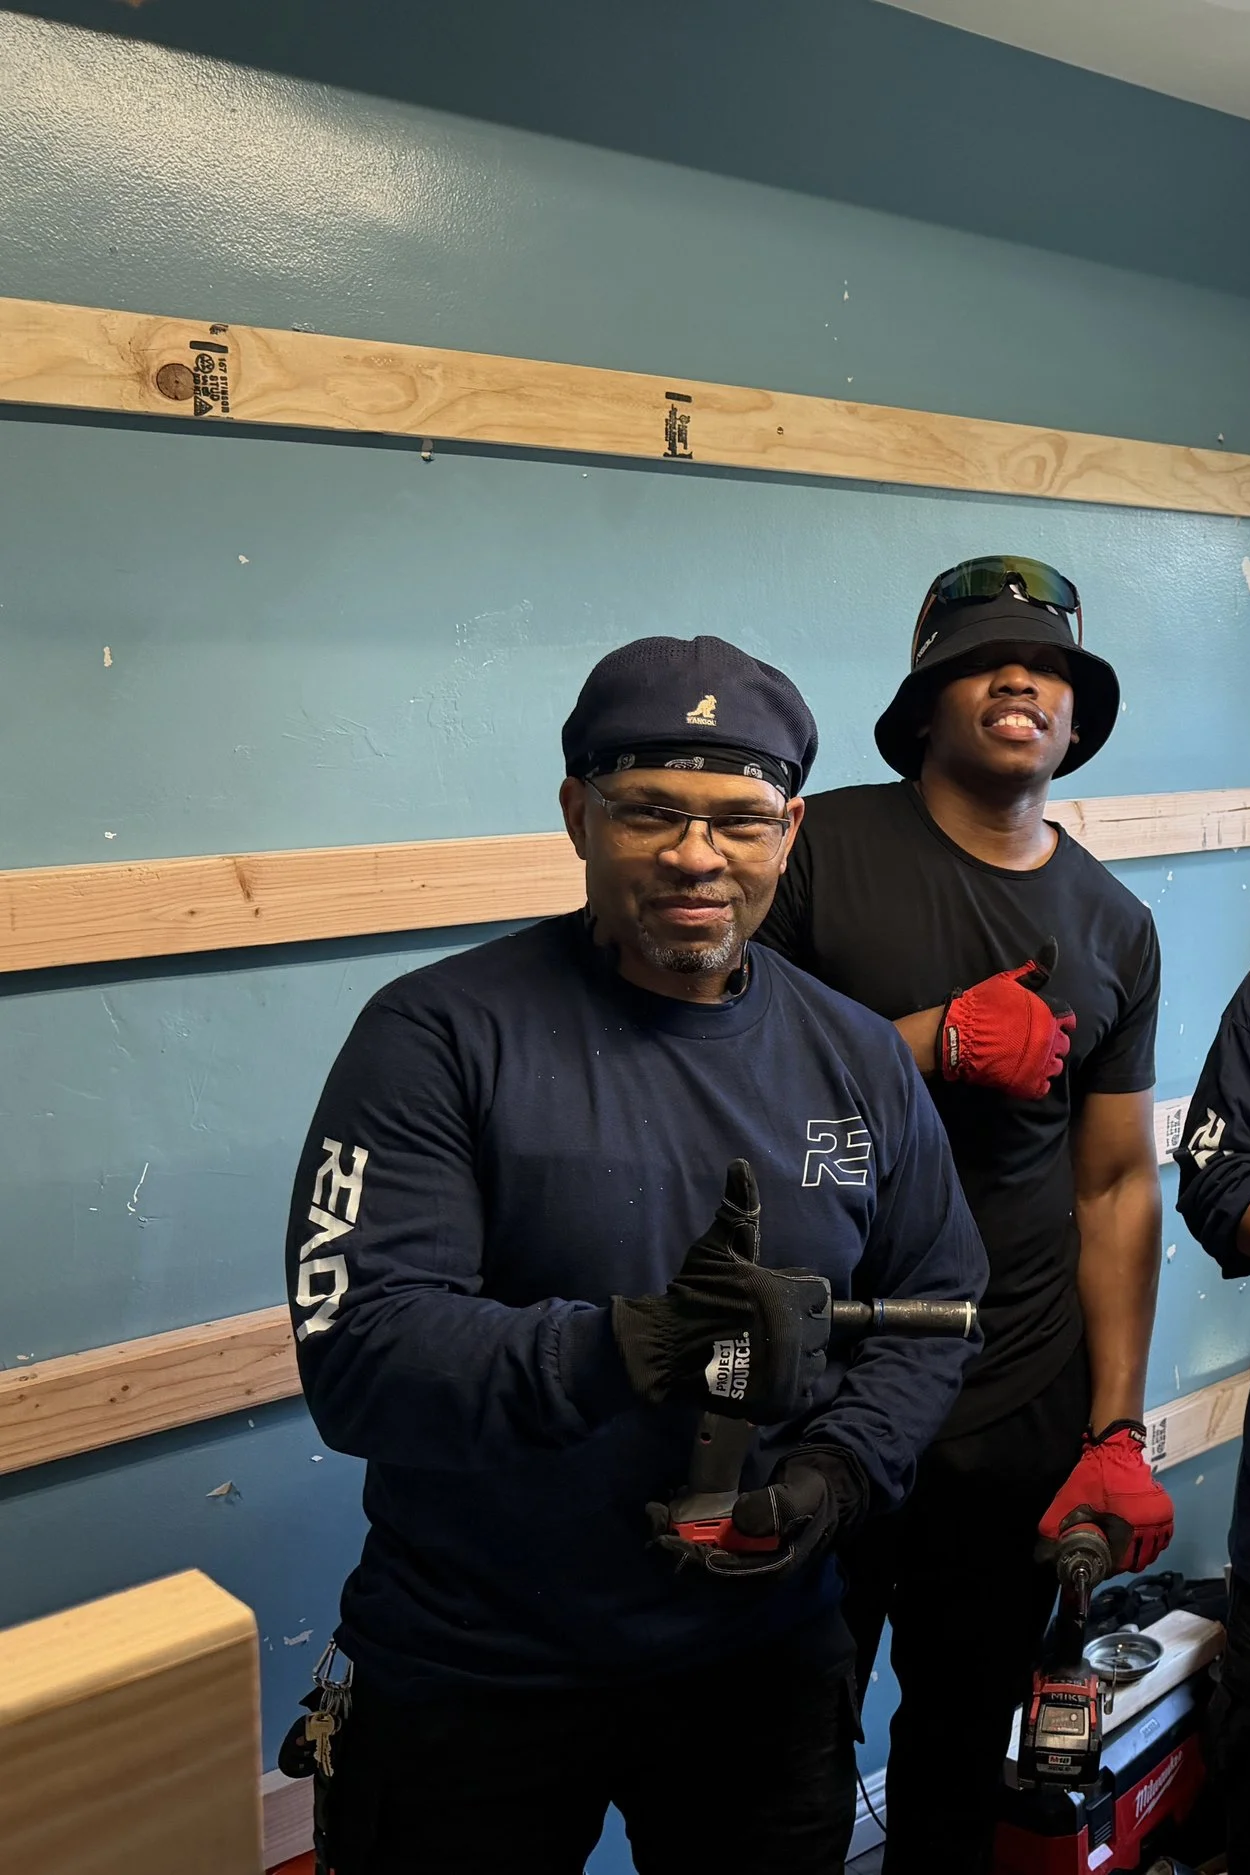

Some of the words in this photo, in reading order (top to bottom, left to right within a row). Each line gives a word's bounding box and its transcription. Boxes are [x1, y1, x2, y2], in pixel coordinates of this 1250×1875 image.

[208, 374, 221, 402] STUD
[801, 1116, 873, 1188] RE
[295, 1136, 369, 1343] READY
[715, 1344, 732, 1393] PROJECT
[730, 1337, 751, 1400] SOURCE
[1051, 1692, 1087, 1703] MIKE
[1135, 1749, 1184, 1818] Milwaukee
